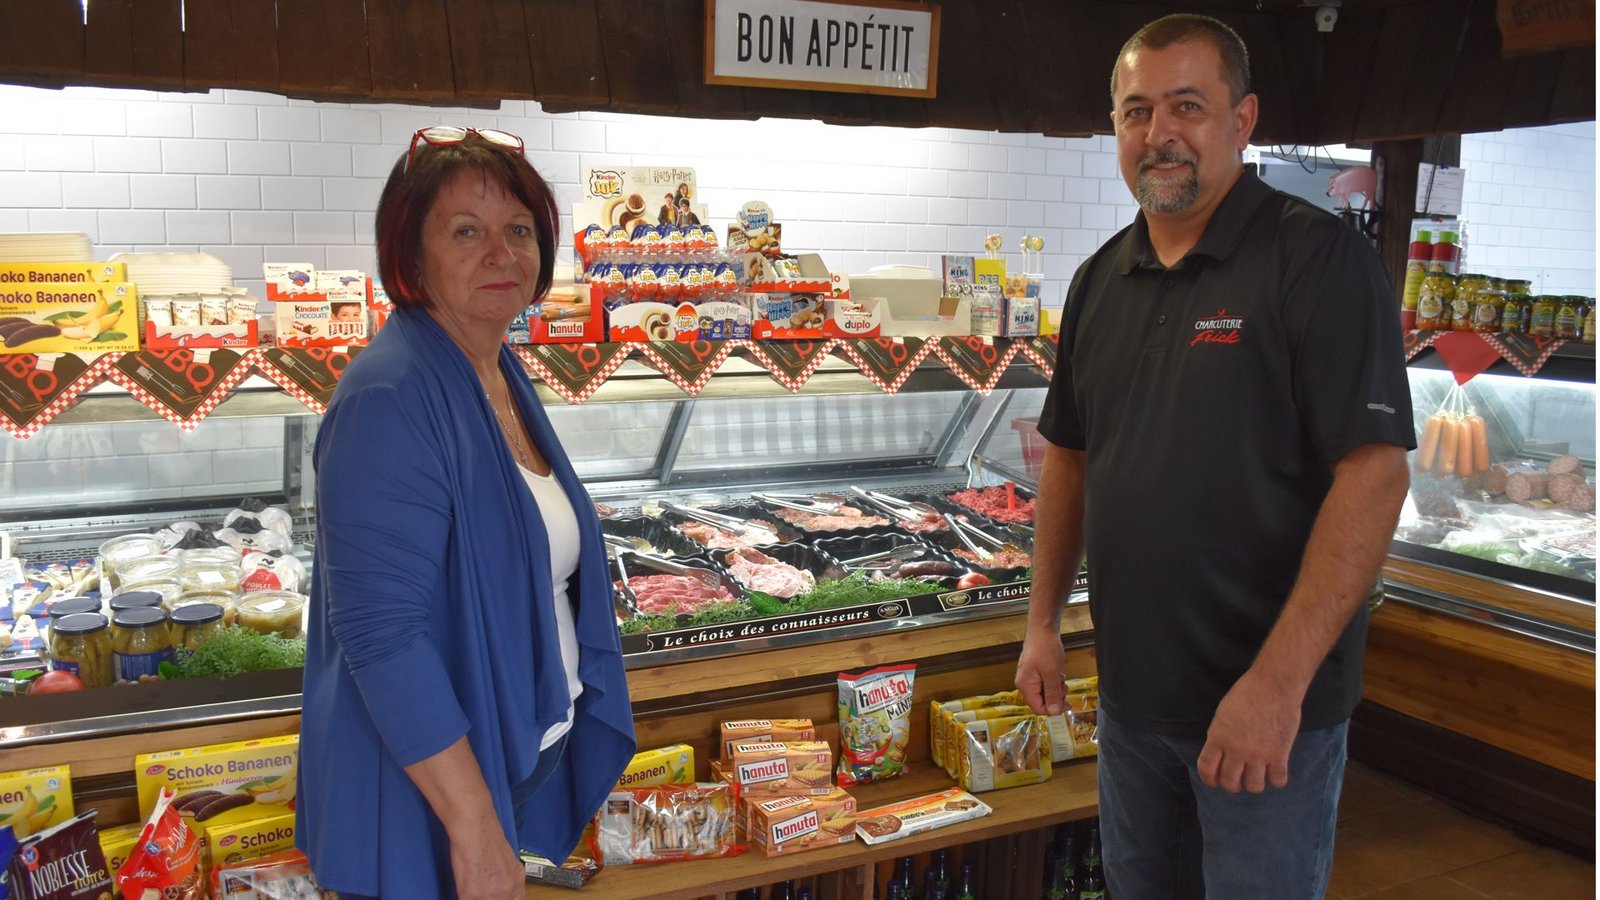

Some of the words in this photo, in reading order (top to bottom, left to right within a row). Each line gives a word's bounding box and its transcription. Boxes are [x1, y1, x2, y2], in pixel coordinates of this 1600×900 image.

[737, 12, 795, 65] BON
[806, 14, 914, 73] APPÉTIT
[654, 170, 672, 183] Harry
[673, 169, 692, 182] Potter
[29, 271, 85, 283] Bananen
[951, 269, 969, 277] KING
[36, 291, 97, 304] Bananen
[844, 320, 871, 331] duplo
[1014, 314, 1035, 323] KING
[1194, 319, 1243, 330] CHARCUTERIE
[550, 324, 583, 334] hanuta
[978, 591, 994, 600] Le
[997, 585, 1031, 598] choix
[664, 637, 683, 648] Le
[690, 630, 734, 643] choix
[741, 624, 765, 636] des
[771, 608, 870, 632] connaisseurs
[859, 679, 908, 708] hanuta
[727, 721, 771, 729] hanuta
[740, 743, 785, 752] hanuta
[167, 763, 224, 781] Schoko
[227, 755, 292, 773] Bananen
[741, 761, 787, 781] hanuta
[619, 765, 666, 786] Bananen
[764, 796, 807, 810] hanuta
[775, 814, 817, 840] hanuta
[241, 827, 294, 849] Schoko
[30, 849, 90, 900] NOBLESSE
